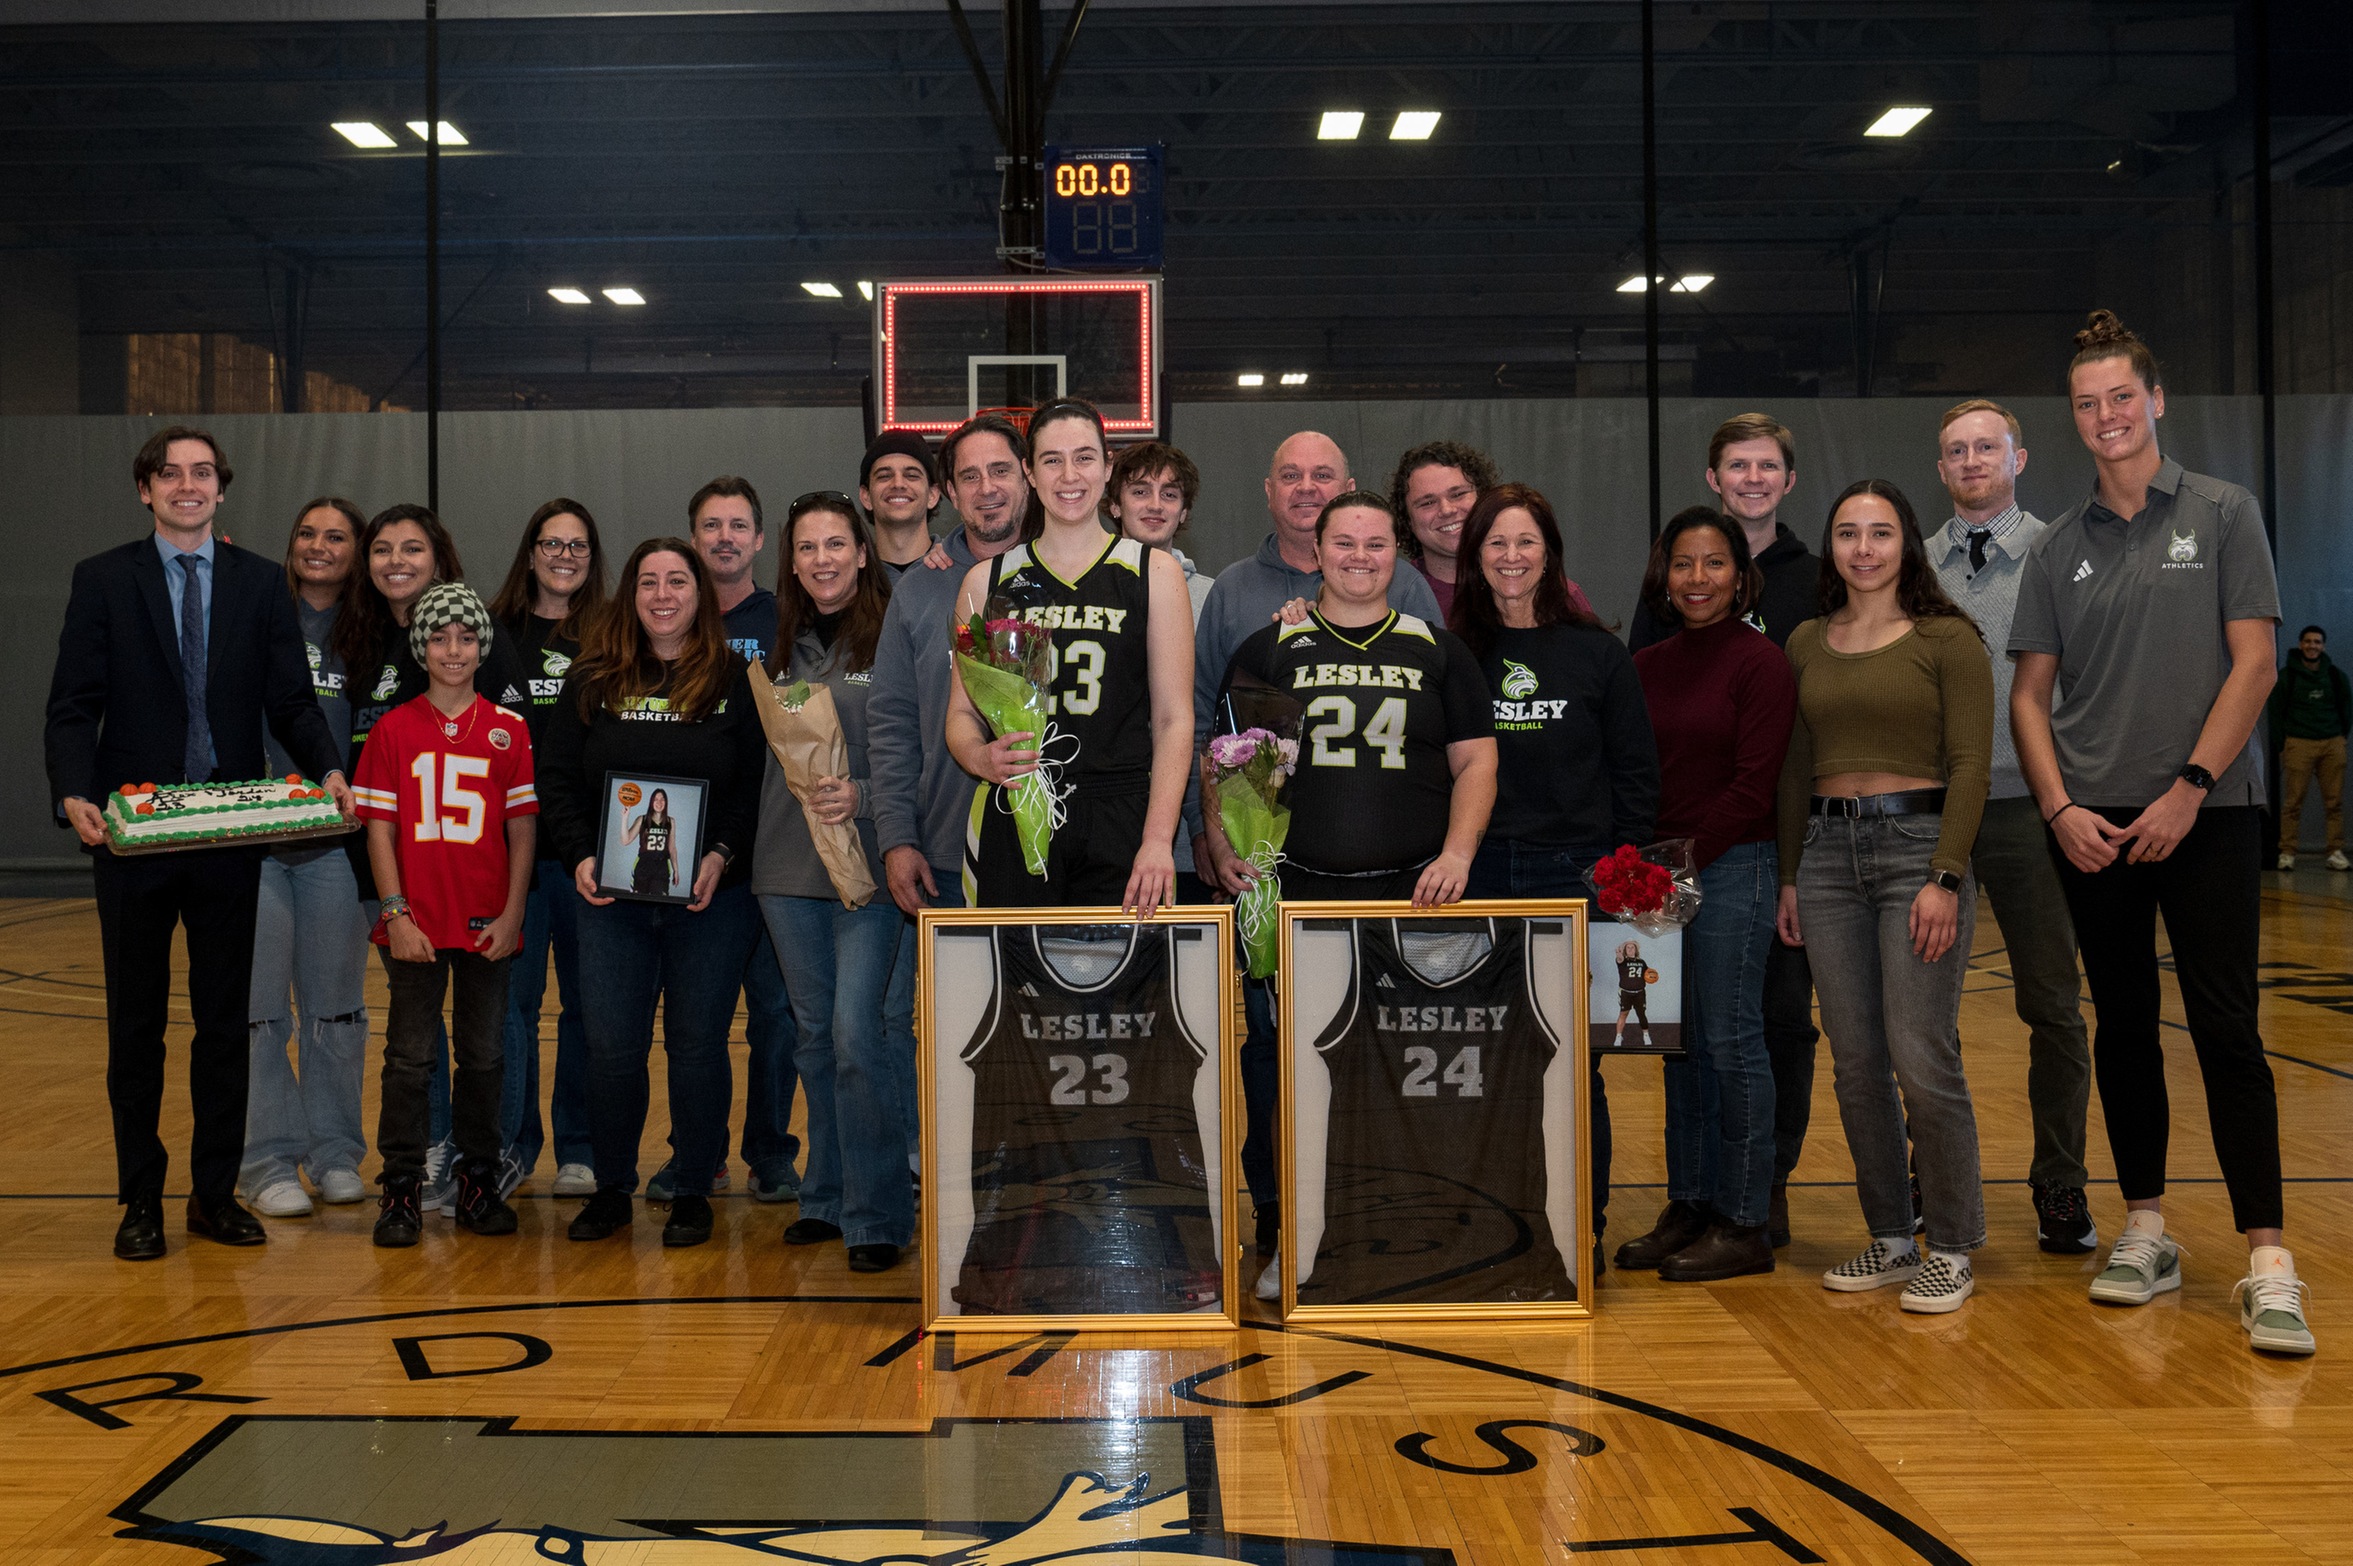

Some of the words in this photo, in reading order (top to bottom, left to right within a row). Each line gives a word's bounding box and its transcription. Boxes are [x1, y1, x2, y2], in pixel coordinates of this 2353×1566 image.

[1056, 164, 1130, 197] 00.0
[2161, 562, 2204, 570] ATHLETICS
[1290, 641, 1317, 649] adidas
[843, 672, 874, 682] LESL
[1292, 663, 1424, 691] LESLEY
[1307, 695, 1407, 769] 24
[411, 752, 491, 845] 15
[646, 835, 666, 851] 23
[1628, 967, 1642, 978] 24
[1019, 1011, 1157, 1040] LESLEY
[1376, 1004, 1508, 1033] LESLEY
[1049, 1053, 1129, 1106] 23
[1401, 1045, 1484, 1098] 24
